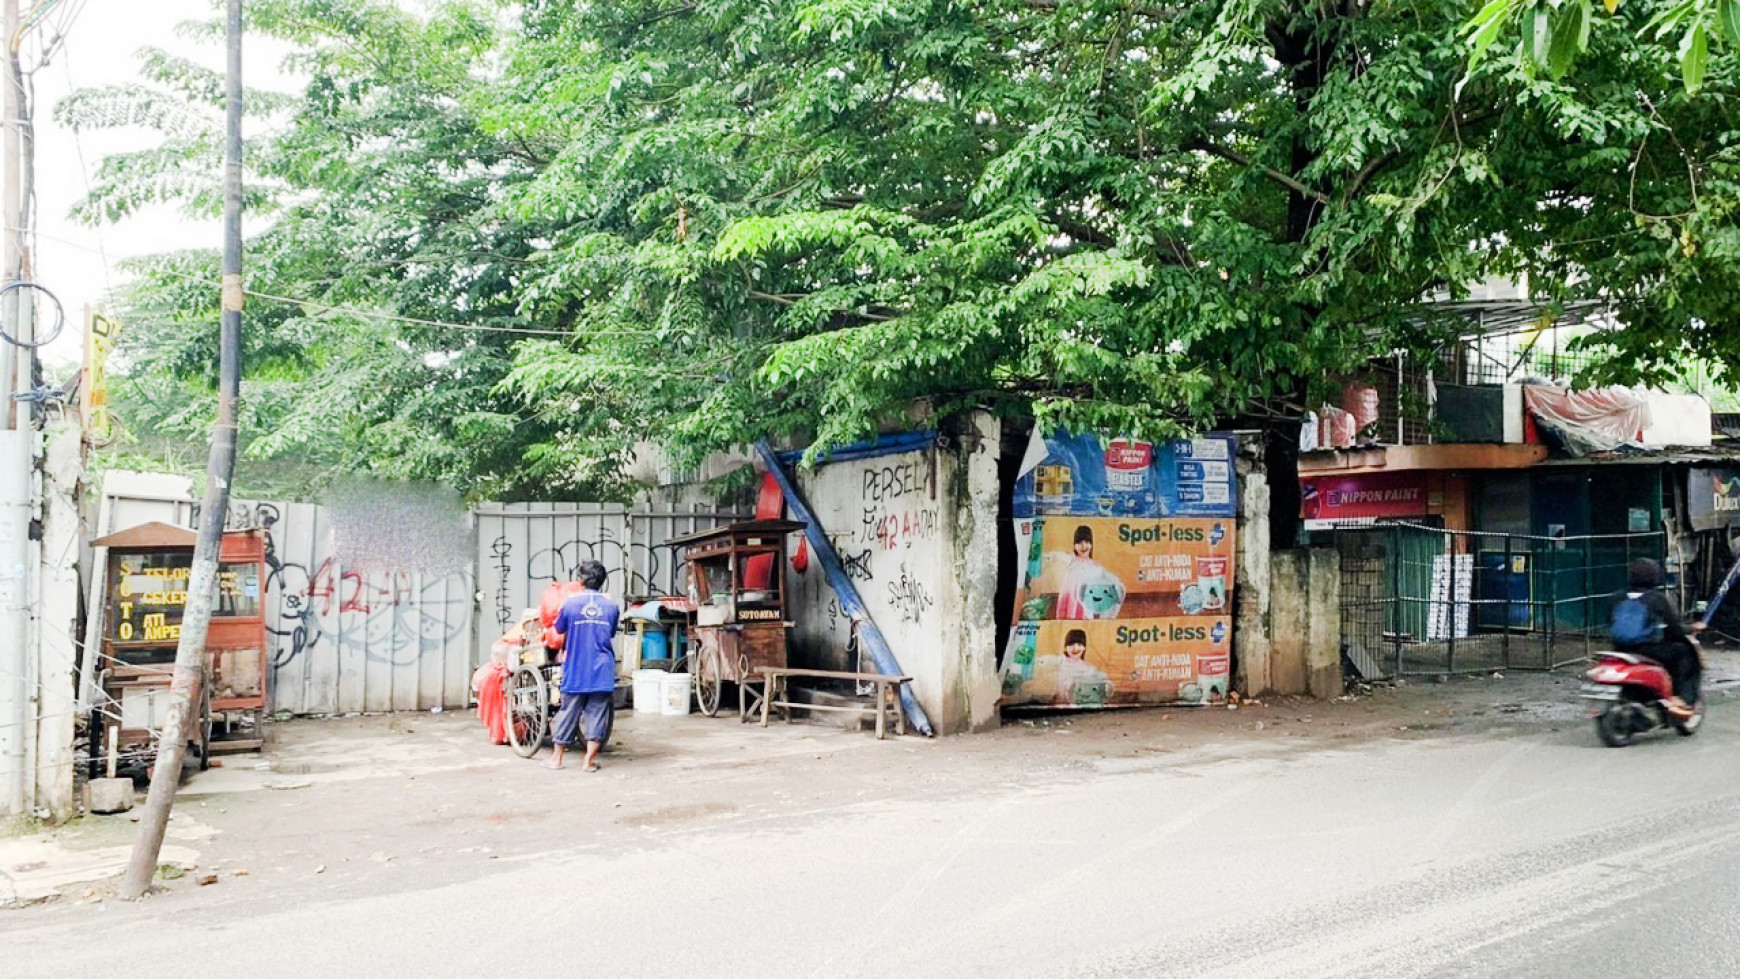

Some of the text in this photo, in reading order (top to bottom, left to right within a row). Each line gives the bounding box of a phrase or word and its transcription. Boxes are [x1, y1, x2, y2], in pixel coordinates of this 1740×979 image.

[1341, 487, 1420, 504] NIPPON PAINT
[120, 562, 134, 641] SOTO
[143, 612, 166, 629] ATI
[143, 624, 183, 641] AMPE
